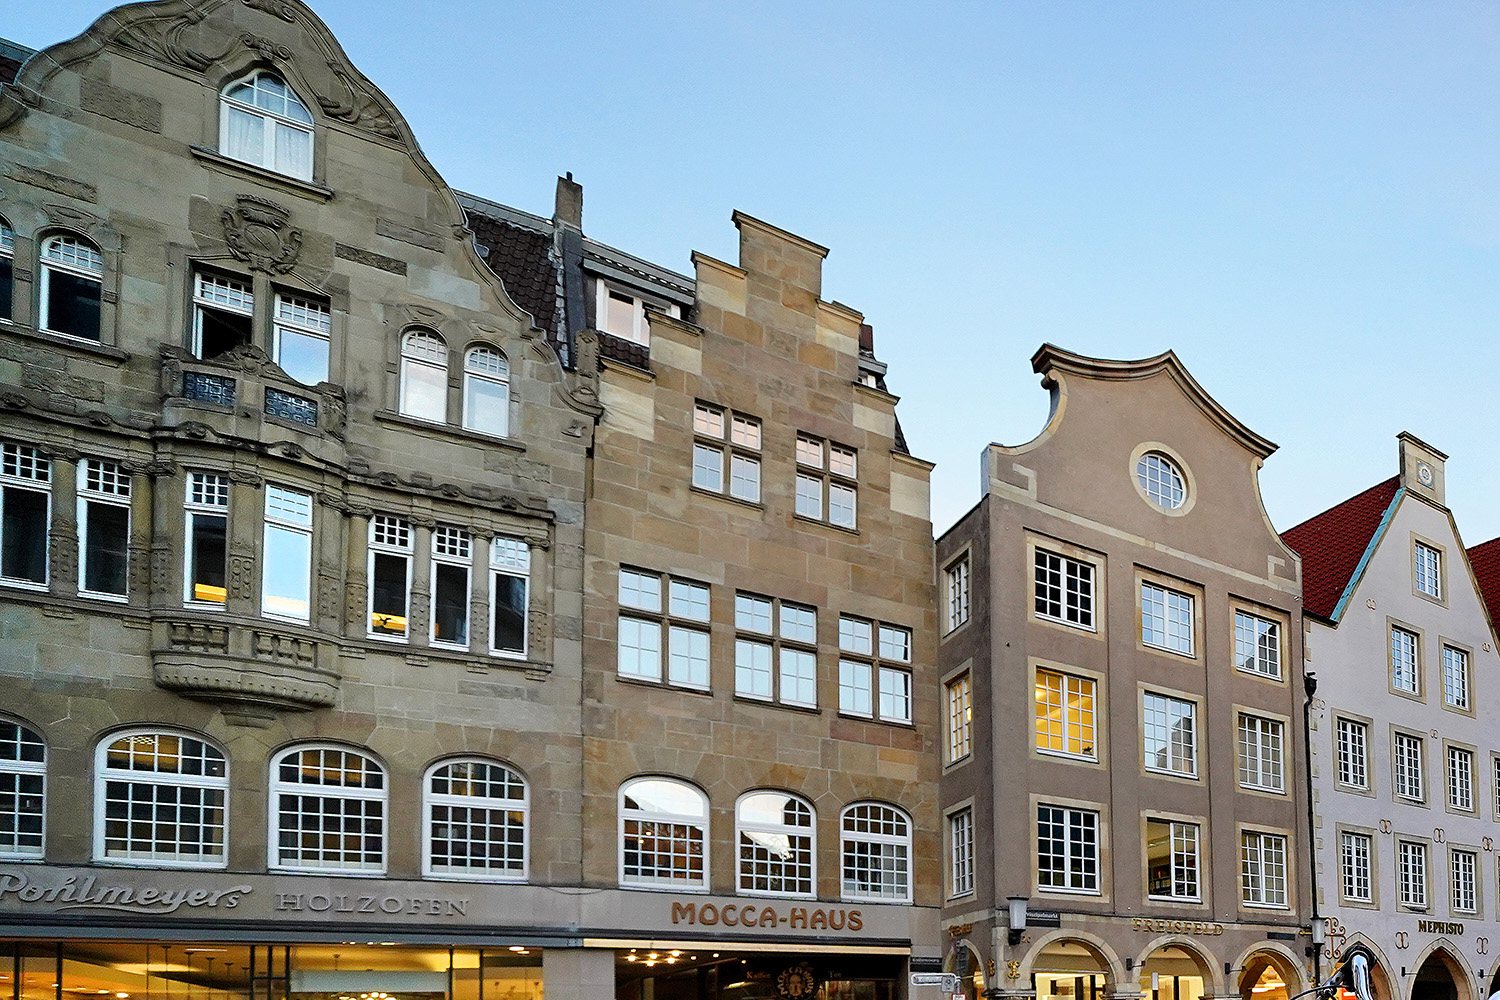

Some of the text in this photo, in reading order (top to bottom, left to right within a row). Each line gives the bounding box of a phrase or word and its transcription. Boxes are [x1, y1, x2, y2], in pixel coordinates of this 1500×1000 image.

[276, 893, 469, 916] HOLZOFEN
[671, 902, 864, 931] MOCCA-HAUS
[1132, 918, 1224, 936] FREISFELD
[1418, 919, 1464, 935] MEPHISTO
